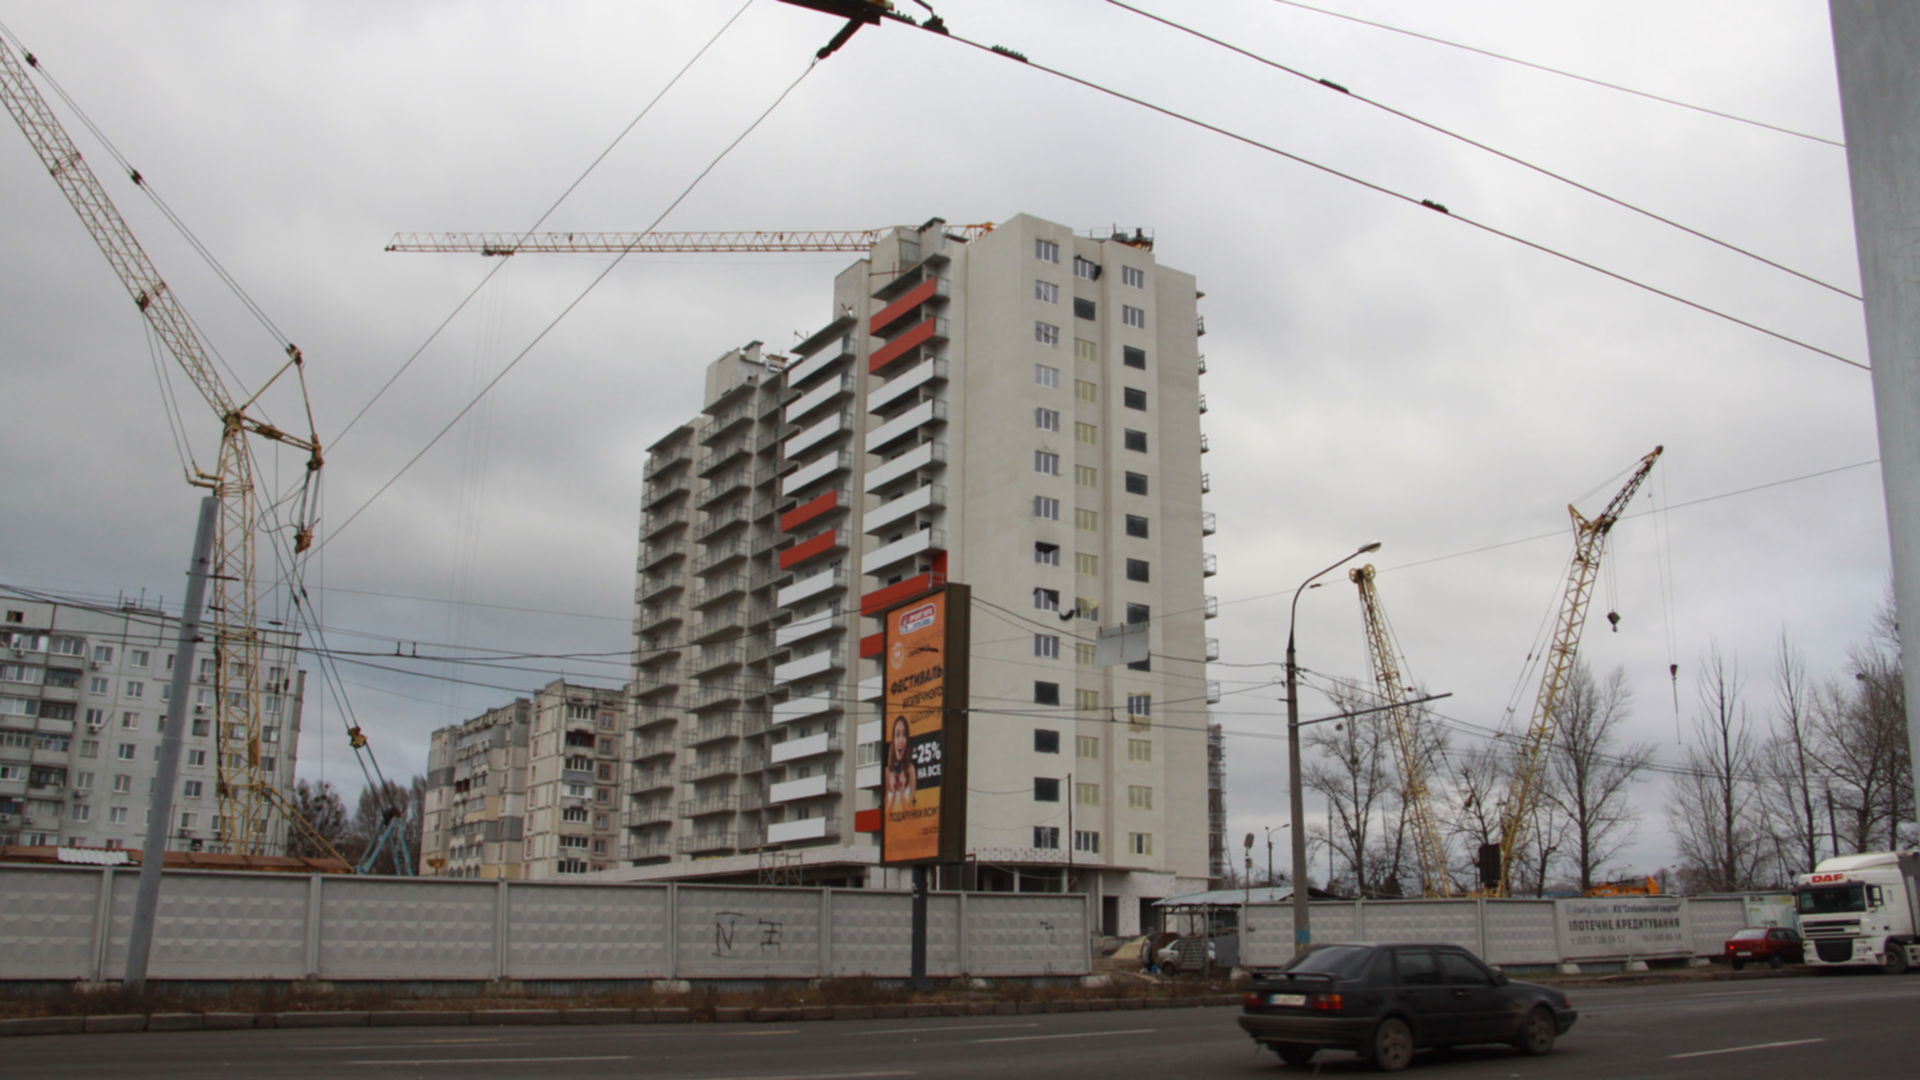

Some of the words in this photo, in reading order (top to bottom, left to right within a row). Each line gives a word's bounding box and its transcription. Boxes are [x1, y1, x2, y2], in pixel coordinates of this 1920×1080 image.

[1811, 873, 1844, 883] DAF
[1568, 919, 1613, 932] ІПОТЕЧНЕ
[1616, 918, 1680, 930] КРЕДИТУВАННЯ
